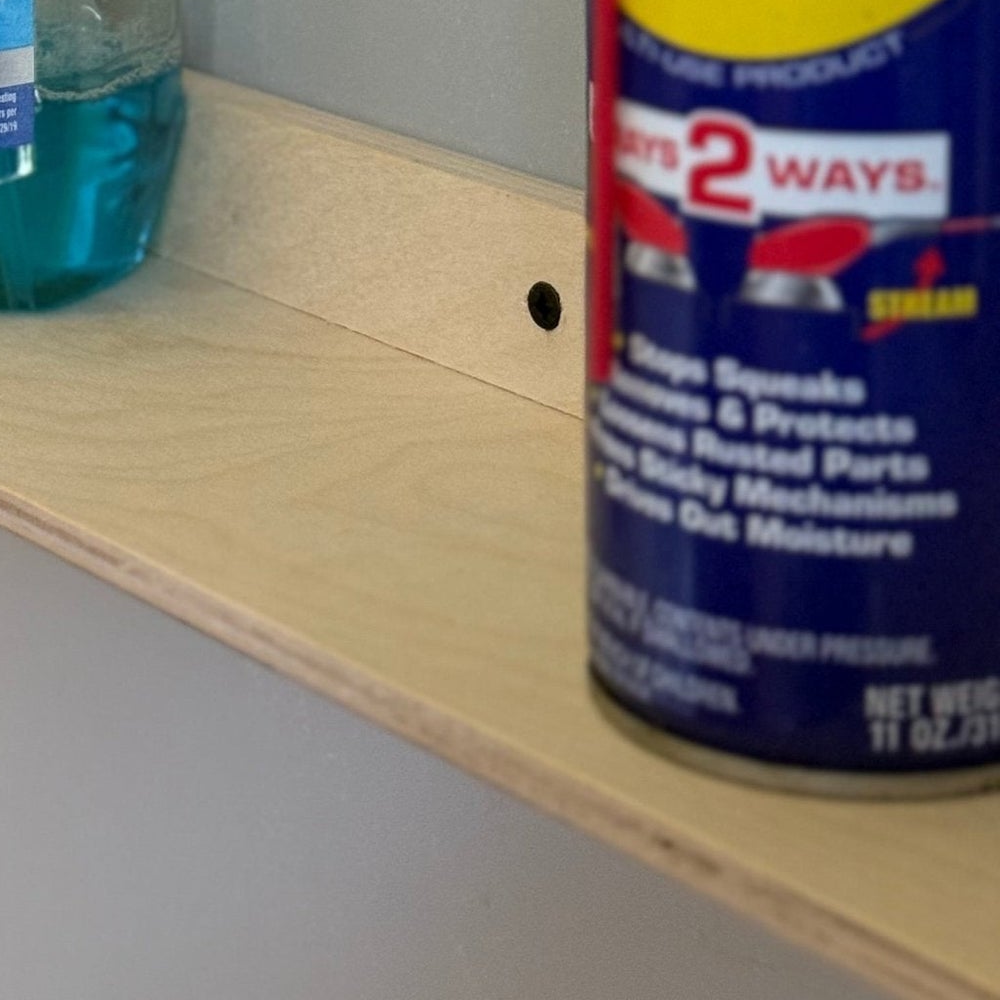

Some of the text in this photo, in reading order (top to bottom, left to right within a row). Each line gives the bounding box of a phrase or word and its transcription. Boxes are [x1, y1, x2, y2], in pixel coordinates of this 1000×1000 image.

[732, 29, 904, 89] PRODUCT
[6, 107, 17, 119] per
[687, 118, 753, 214] 2
[714, 356, 867, 406] Squeaks
[716, 396, 746, 430] &
[752, 402, 917, 444] Protects
[692, 427, 814, 479] Rusted
[822, 447, 930, 482] Parts
[637, 447, 729, 508] Sticky
[733, 473, 959, 520] Mechanisms
[679, 498, 740, 543] Out
[745, 510, 914, 560] Moisture
[863, 683, 922, 721] NET
[871, 718, 900, 753] 11
